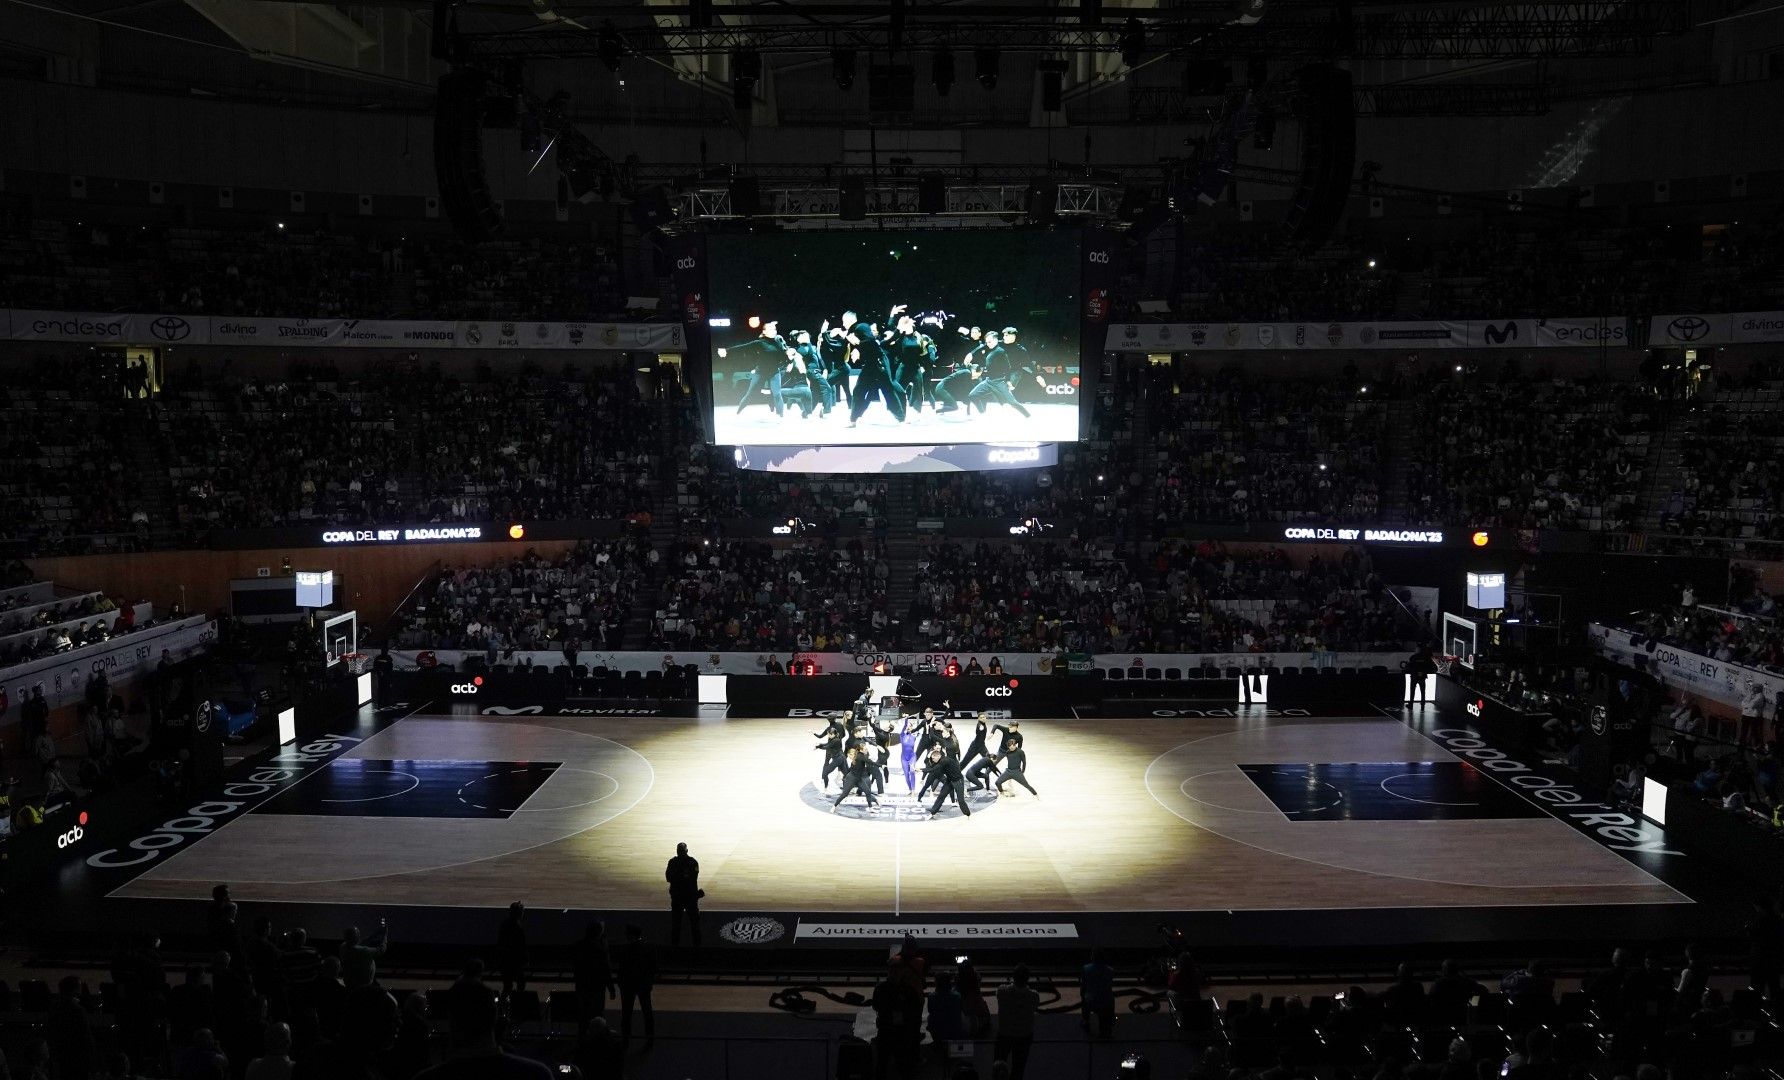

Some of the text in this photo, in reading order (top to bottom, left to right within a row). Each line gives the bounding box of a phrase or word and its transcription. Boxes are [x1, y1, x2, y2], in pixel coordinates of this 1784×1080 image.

[677, 255, 696, 270] acb
[1089, 250, 1110, 264] acb
[32, 319, 122, 336] endesa
[219, 323, 257, 333] divina
[278, 326, 329, 338] SPALDING
[412, 331, 454, 340] MONDO
[1045, 383, 1075, 395] acb
[323, 531, 355, 543] COPA
[356, 531, 377, 541] DEL
[378, 530, 399, 541] REY
[1285, 528, 1316, 539] COPA
[1317, 529, 1337, 539] DEL
[1338, 529, 1360, 540] REY
[91, 655, 118, 674] COPA
[136, 644, 152, 660] REY
[854, 654, 893, 666] COPA
[925, 654, 951, 666] REY
[1656, 649, 1680, 668] COPA
[1700, 662, 1719, 678] REY
[451, 682, 478, 694] acb
[984, 684, 1013, 697] acb
[558, 707, 661, 715] Movistar
[1466, 702, 1480, 717] acb
[1431, 728, 1688, 857] Copa del Rey
[86, 733, 363, 868] Copa del Rey
[57, 824, 84, 849] acb
[811, 926, 1059, 937] Ajuntament de Badalona
